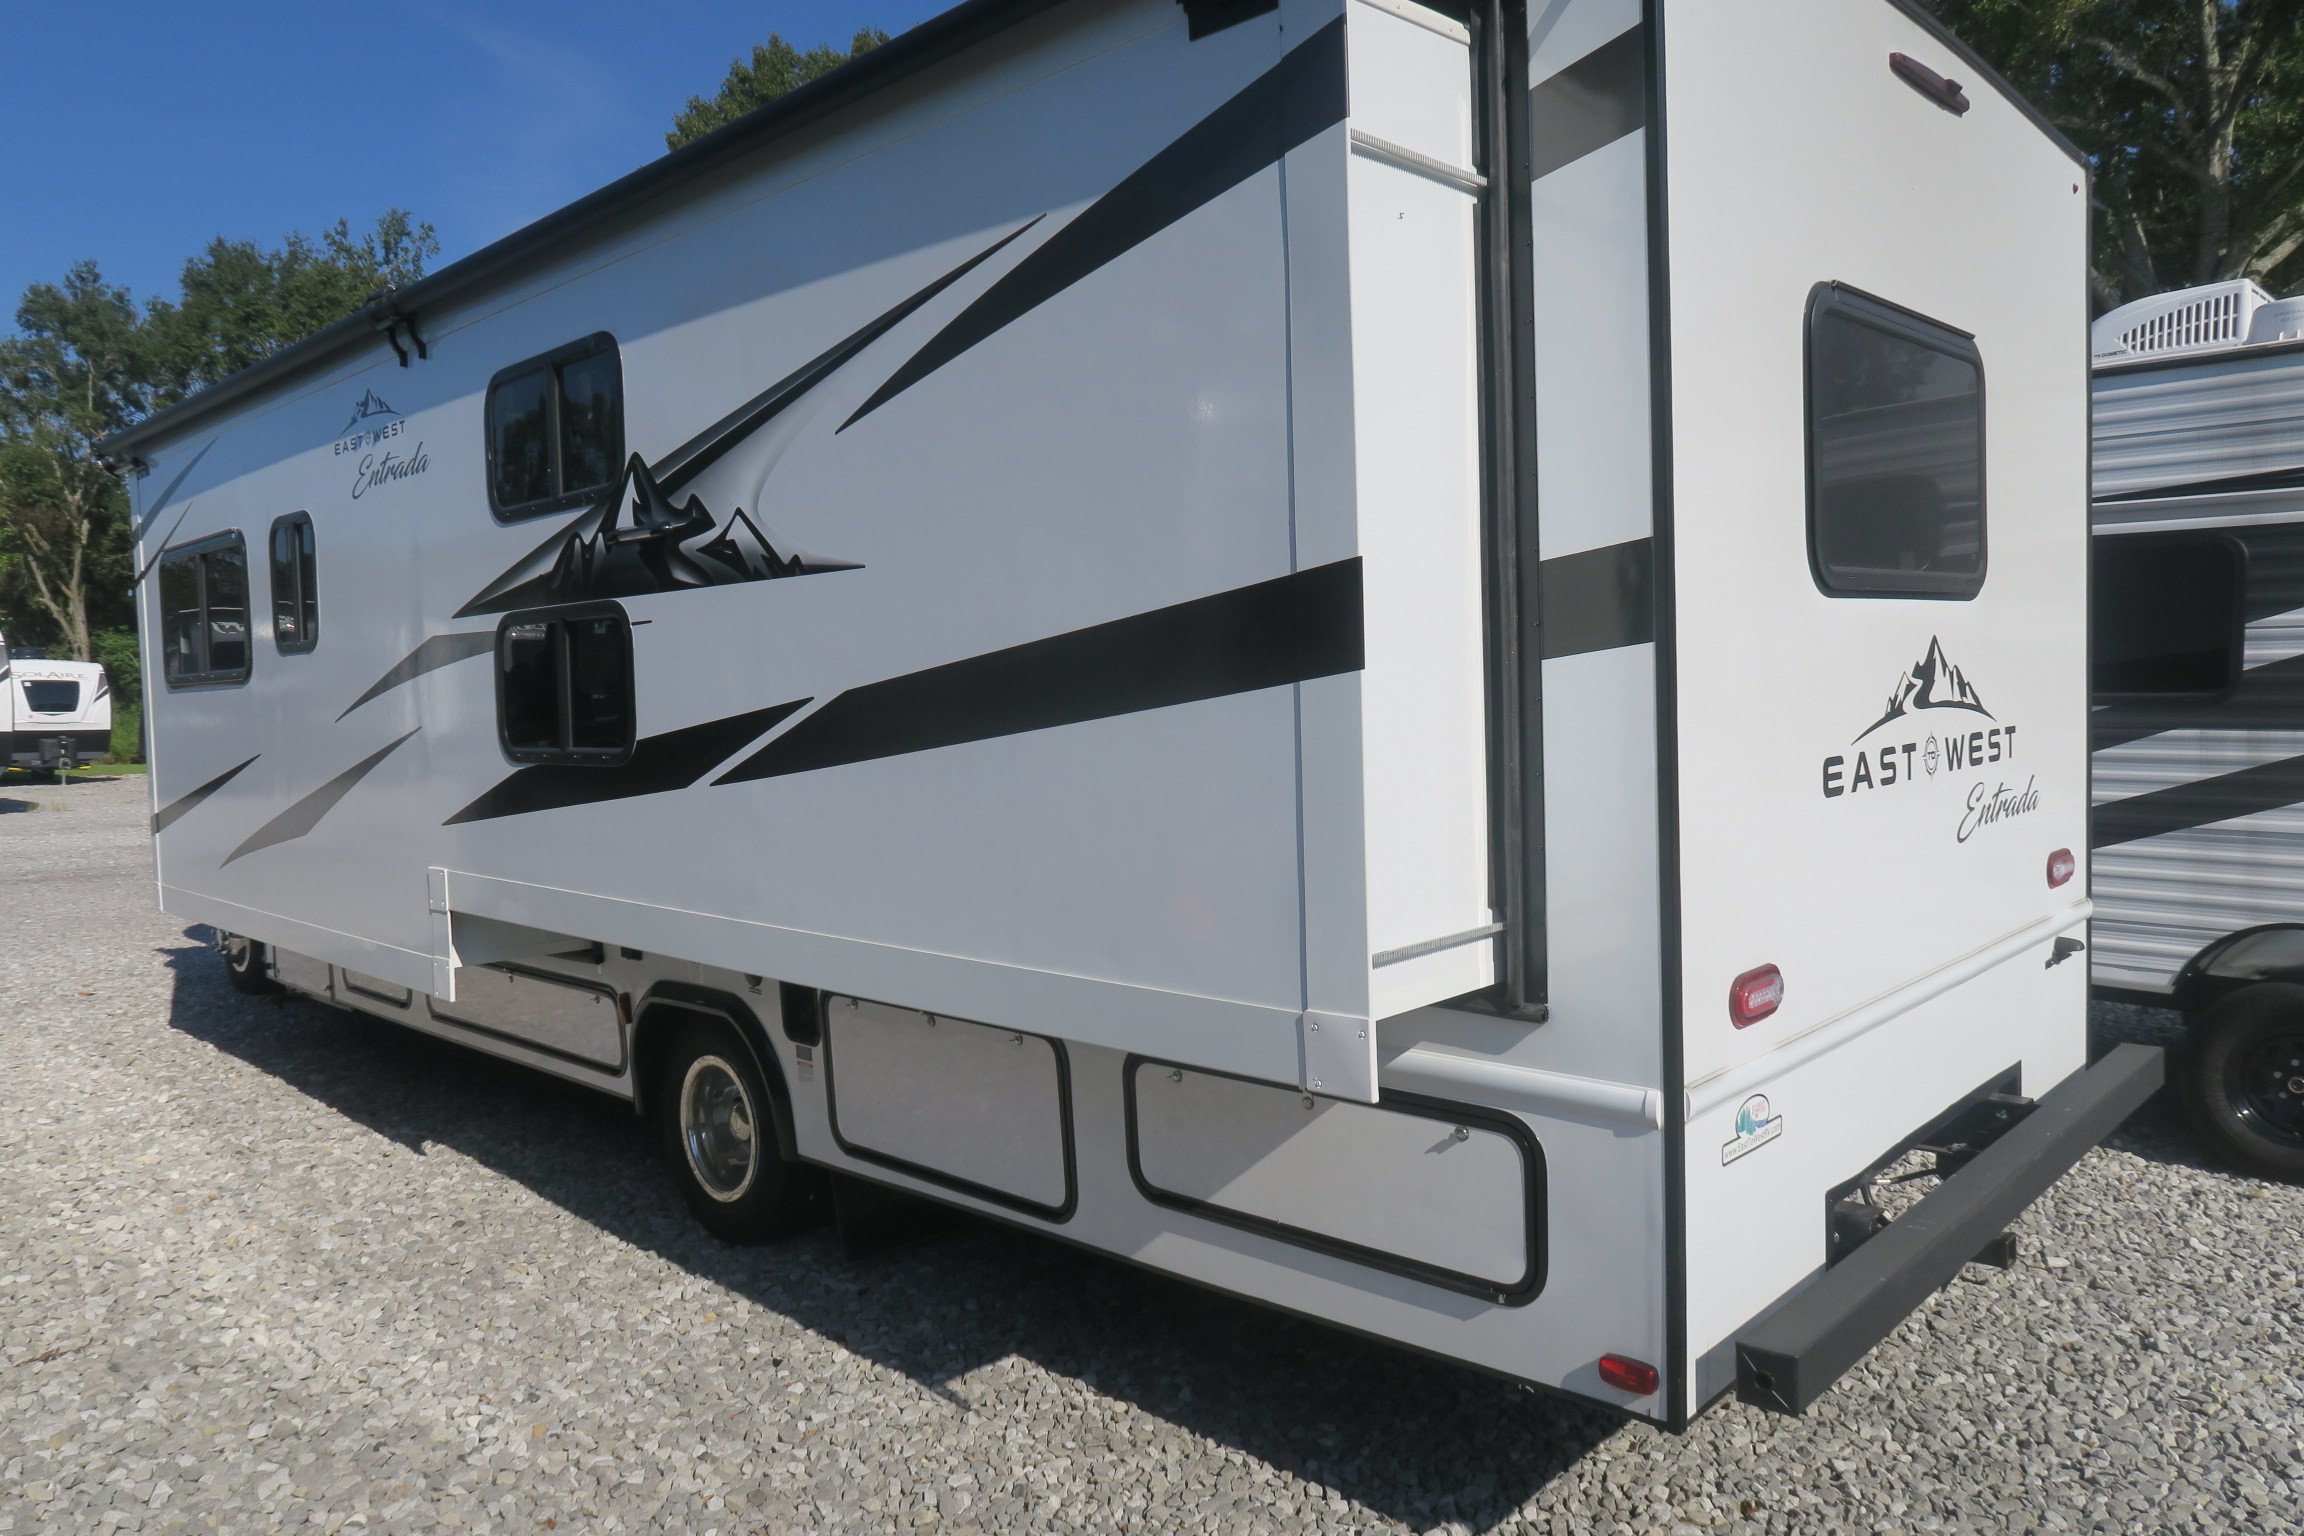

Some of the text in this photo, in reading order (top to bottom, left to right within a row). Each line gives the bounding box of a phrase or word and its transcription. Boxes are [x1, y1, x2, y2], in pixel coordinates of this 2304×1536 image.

[334, 420, 406, 456] EAST WEST
[352, 441, 431, 499] Entrada
[1823, 742, 1917, 798] EAST
[1945, 725, 2016, 772] WEST
[1956, 774, 2040, 844] Entrada
